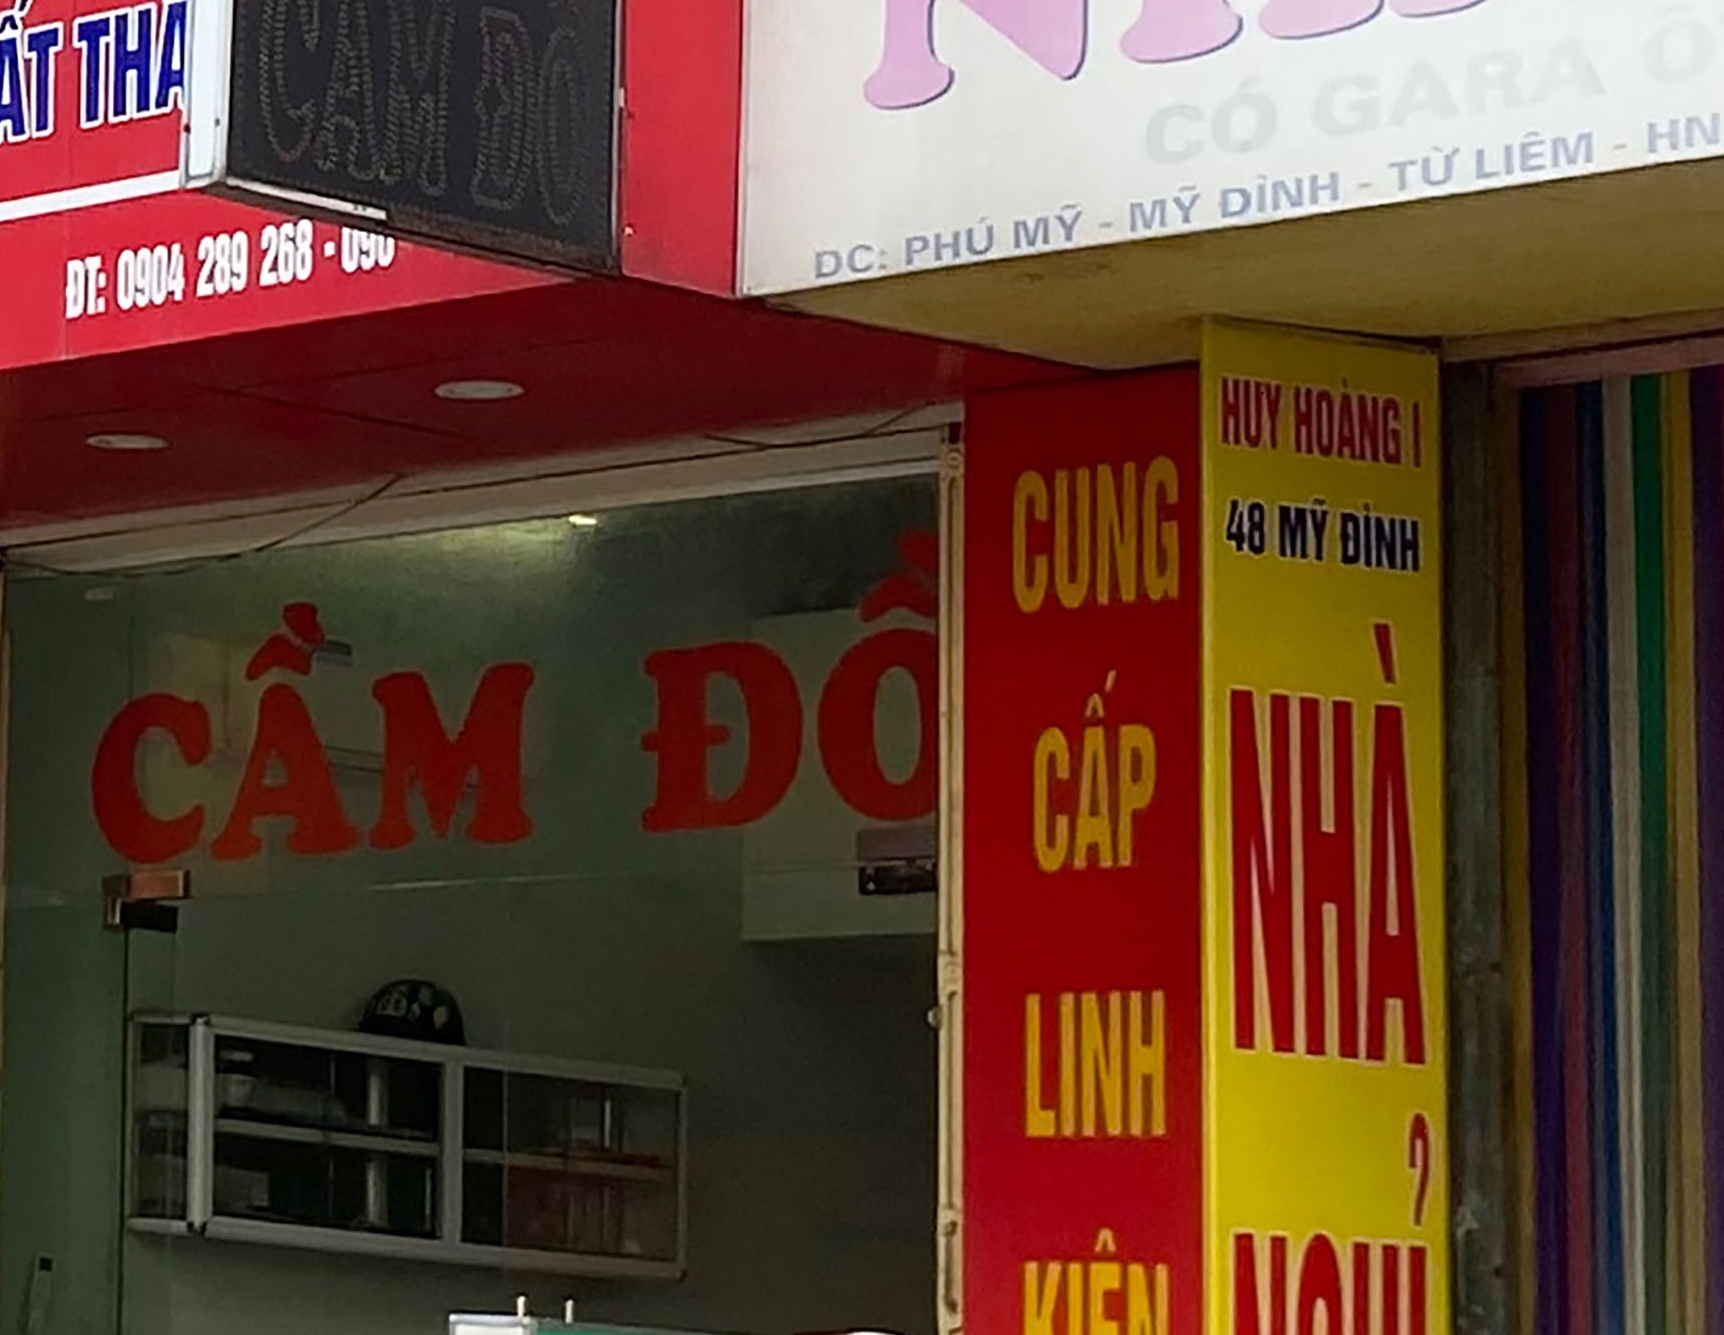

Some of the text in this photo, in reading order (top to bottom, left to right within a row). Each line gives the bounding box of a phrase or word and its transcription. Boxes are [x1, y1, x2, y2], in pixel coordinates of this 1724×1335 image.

[1146, 33, 1605, 167] CÓ GARA
[904, 112, 1721, 265] PHÚ MỸ MỸ ĐÌNH TỪ LIÊM HN
[66, 219, 312, 319] ĐT: 0904 289 268
[1220, 375, 1402, 467] HUY HOÀNG
[1012, 455, 1180, 614] CUNG
[1225, 498, 1421, 573] 48 MỸ ĐÌNH
[91, 527, 939, 864] CẦM ĐỒ
[1032, 670, 1156, 873] CẤP
[1229, 620, 1427, 1064] NHÀ
[1024, 990, 1166, 1139] LINH
